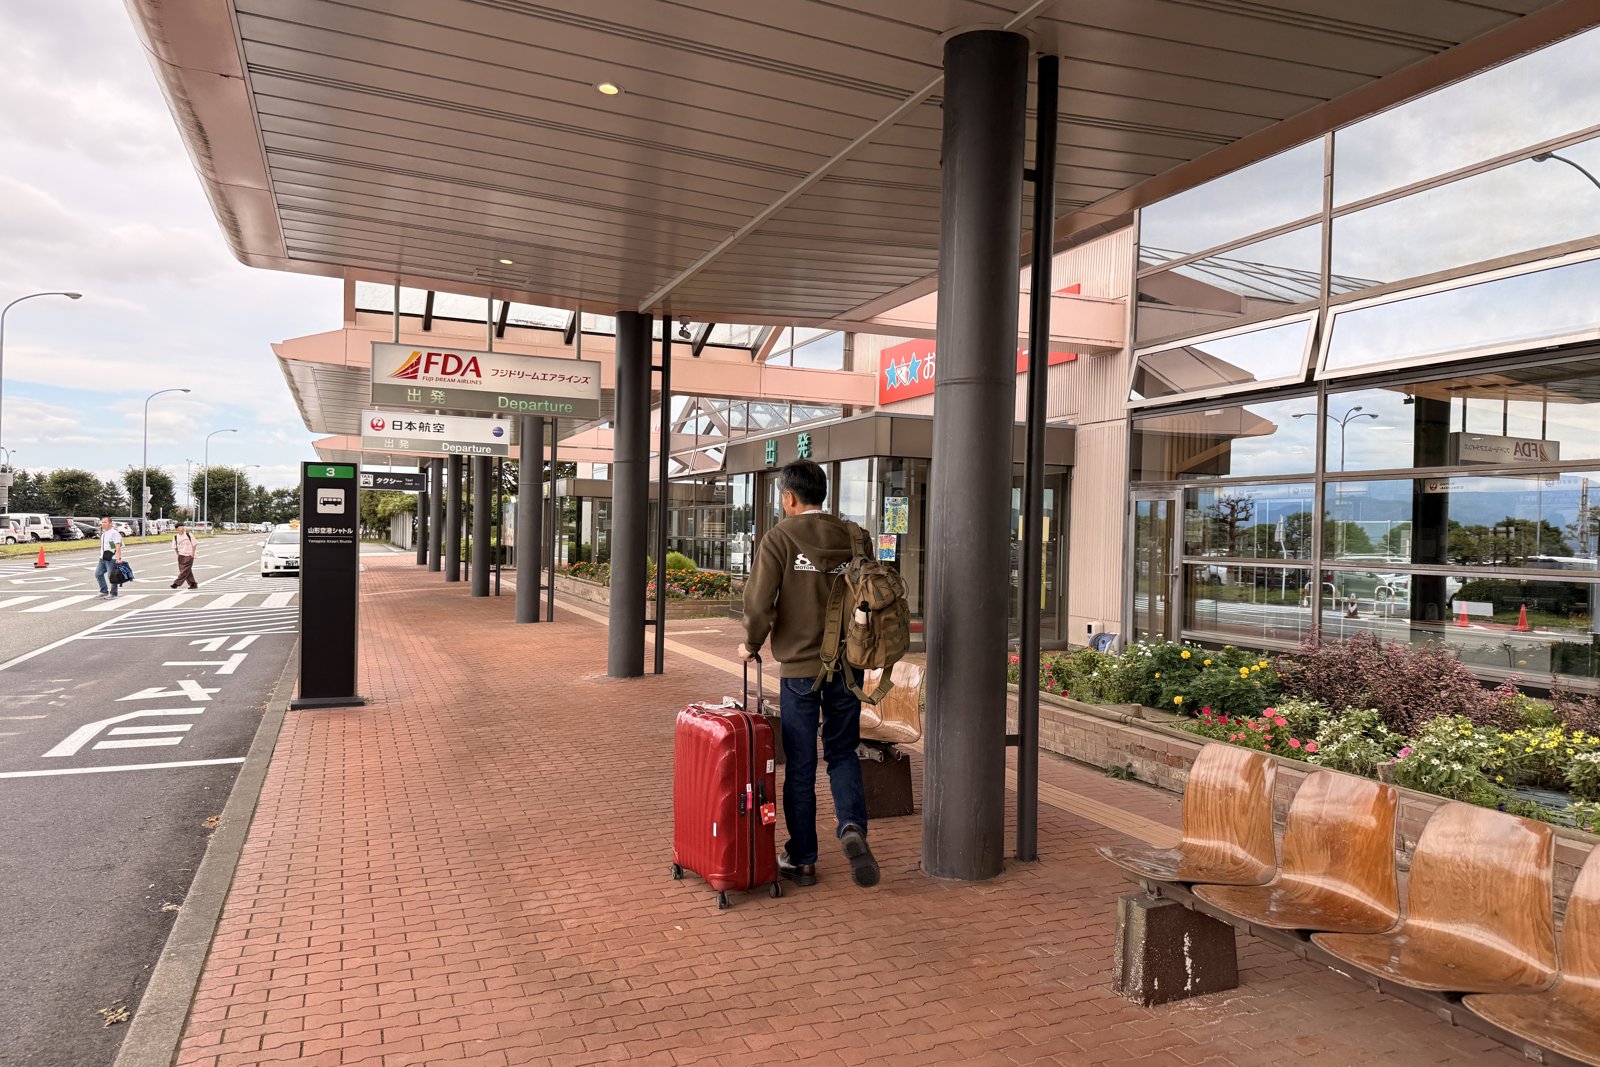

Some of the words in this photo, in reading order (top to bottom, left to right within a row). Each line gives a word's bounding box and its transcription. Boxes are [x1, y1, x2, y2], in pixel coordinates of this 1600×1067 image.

[423, 352, 482, 378] FDA
[435, 376, 456, 384] DREAM
[491, 368, 591, 385] フジドリームエアラインズ
[498, 396, 573, 414] Departure
[392, 420, 445, 433] 日本航空
[442, 442, 492, 454] Departure
[326, 467, 335, 477] 3
[376, 477, 403, 485] タクシー
